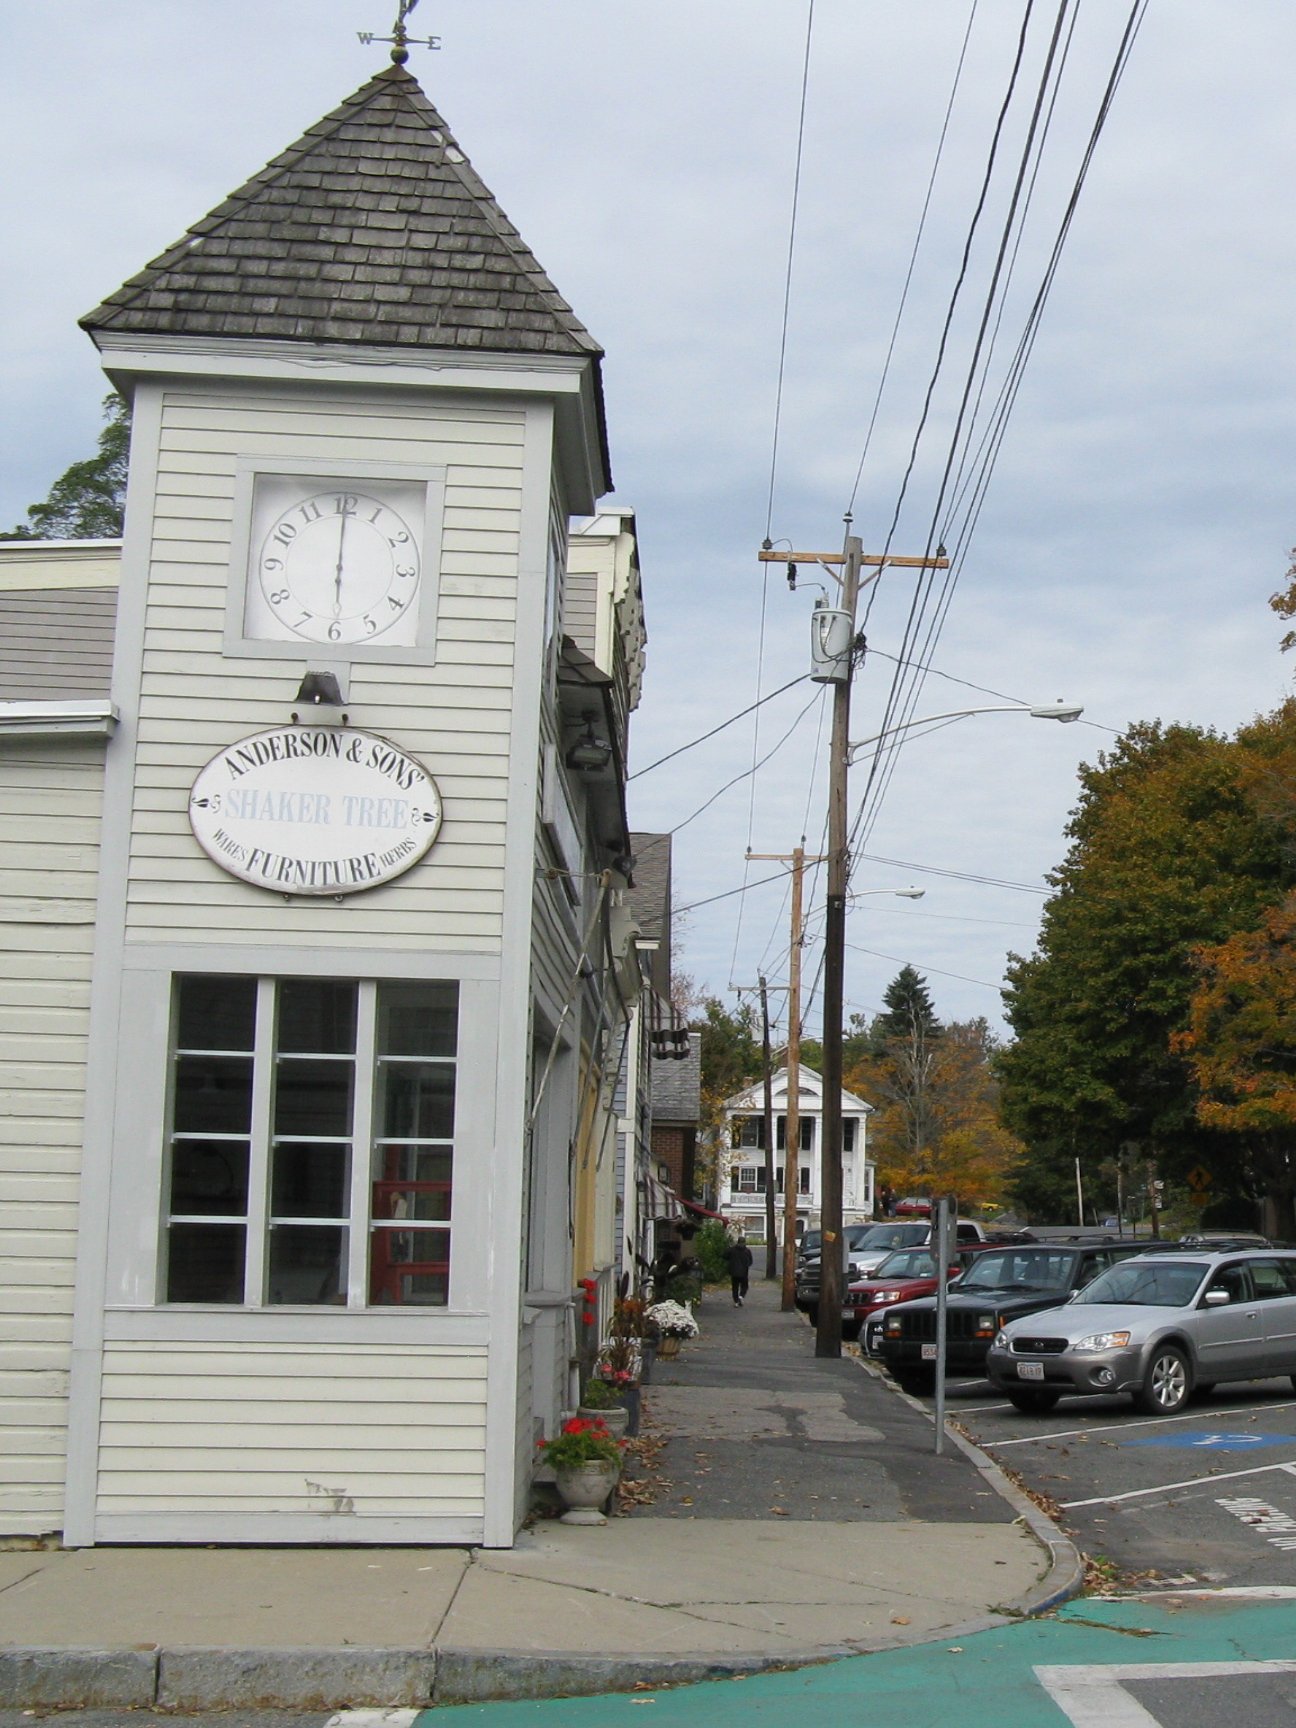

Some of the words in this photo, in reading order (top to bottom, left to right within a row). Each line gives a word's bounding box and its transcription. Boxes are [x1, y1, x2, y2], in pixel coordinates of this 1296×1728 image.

[356, 32, 374, 45] W
[427, 36, 441, 50] E
[298, 501, 324, 525] 11
[334, 495, 358, 516] 12
[368, 507, 383, 525] 1
[272, 522, 297, 548] 10
[387, 531, 409, 548] 2
[263, 557, 285, 572] 9
[395, 564, 416, 578] 3
[270, 589, 290, 605] 8
[387, 596, 405, 611] 4
[293, 611, 313, 628] 7
[363, 614, 378, 635] 5
[327, 621, 342, 641] 6
[224, 732, 344, 780] ANDERSON
[346, 737, 362, 763] &
[225, 788, 332, 825] SHAKER
[342, 795, 410, 830] TREE
[212, 828, 248, 862] WARES
[245, 848, 381, 886] FURNITURE
[379, 836, 417, 869] HERBS
